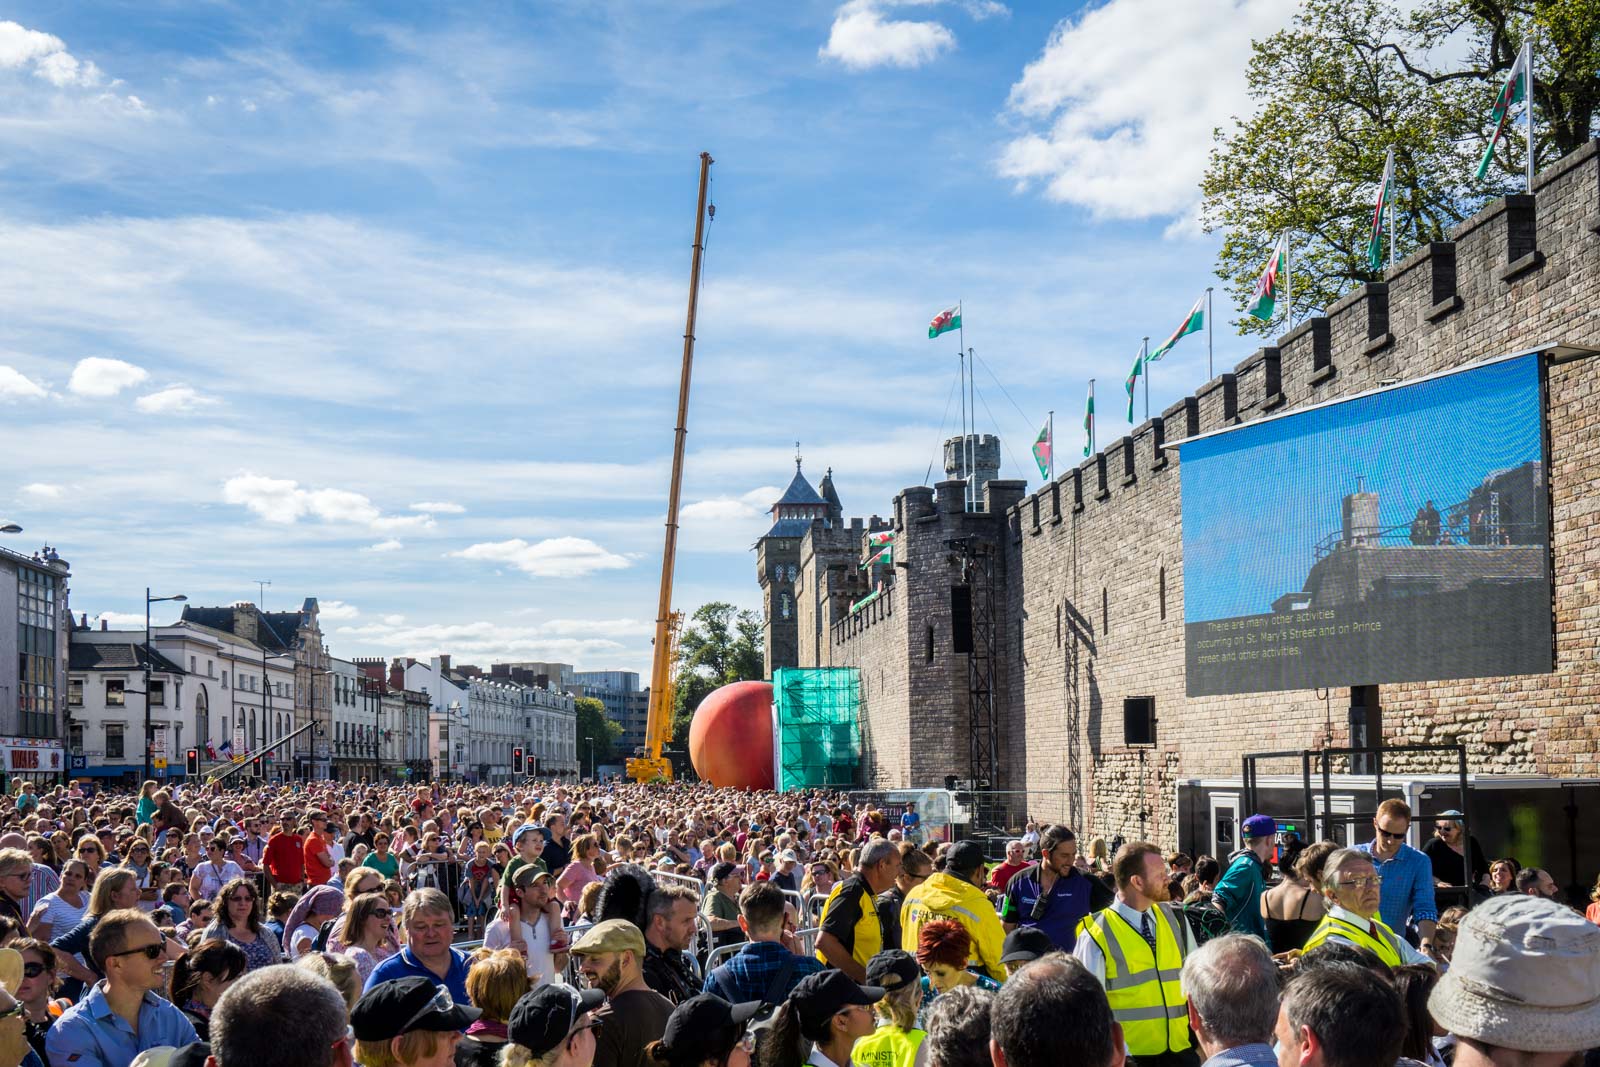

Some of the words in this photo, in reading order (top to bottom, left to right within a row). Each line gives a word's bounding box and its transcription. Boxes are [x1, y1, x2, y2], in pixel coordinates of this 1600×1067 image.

[1207, 621, 1230, 633] There
[1232, 619, 1245, 630] are
[1246, 617, 1269, 629] many
[1271, 613, 1293, 625] other
[1296, 609, 1335, 623] activities
[1197, 635, 1232, 649] occurring
[1234, 635, 1244, 646] on
[1260, 629, 1287, 643] Mary's
[1289, 627, 1317, 640] Street
[1319, 623, 1335, 637] and
[1338, 624, 1349, 634] on
[1352, 620, 1382, 633] Prince
[1198, 653, 1220, 665] street
[1221, 650, 1237, 662] and
[1238, 648, 1260, 661] other
[11, 749, 39, 769] WALES
[861, 1050, 900, 1061] MINISTY
